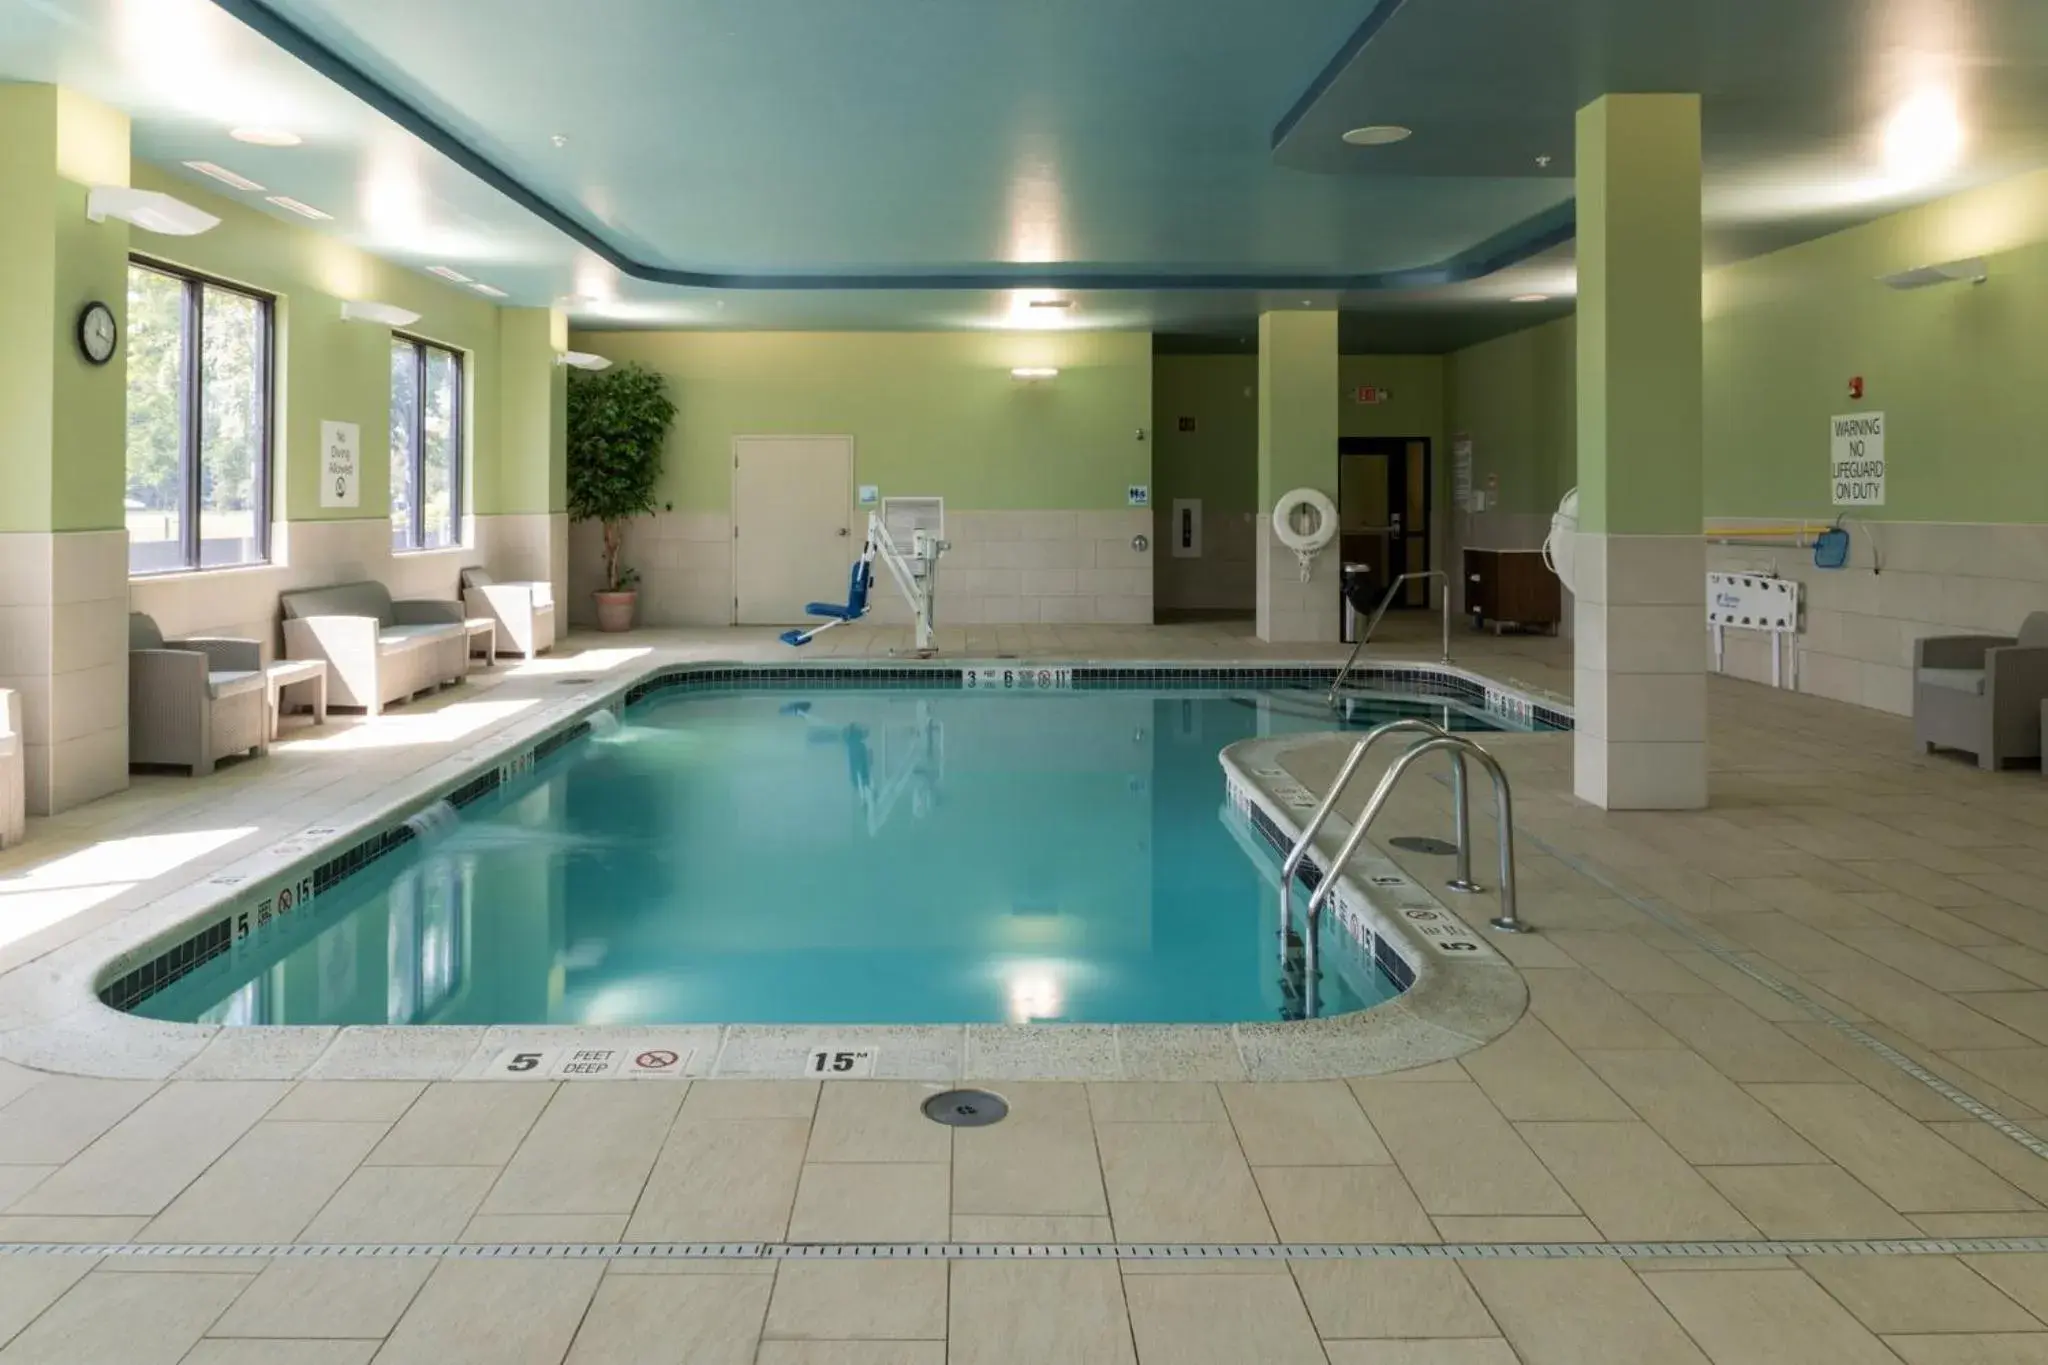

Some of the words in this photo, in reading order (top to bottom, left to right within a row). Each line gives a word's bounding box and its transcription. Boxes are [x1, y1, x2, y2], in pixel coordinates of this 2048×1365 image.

[1834, 417, 1880, 437] WARNING
[1849, 440, 1865, 457] NO
[1832, 460, 1884, 478] LIFEGUARD
[1836, 482, 1850, 499] ON
[1853, 482, 1880, 499] DUTY
[238, 911, 250, 940] 5
[507, 1052, 543, 1072] 5
[573, 1050, 616, 1060] FEET
[563, 1063, 609, 1073] DEEP
